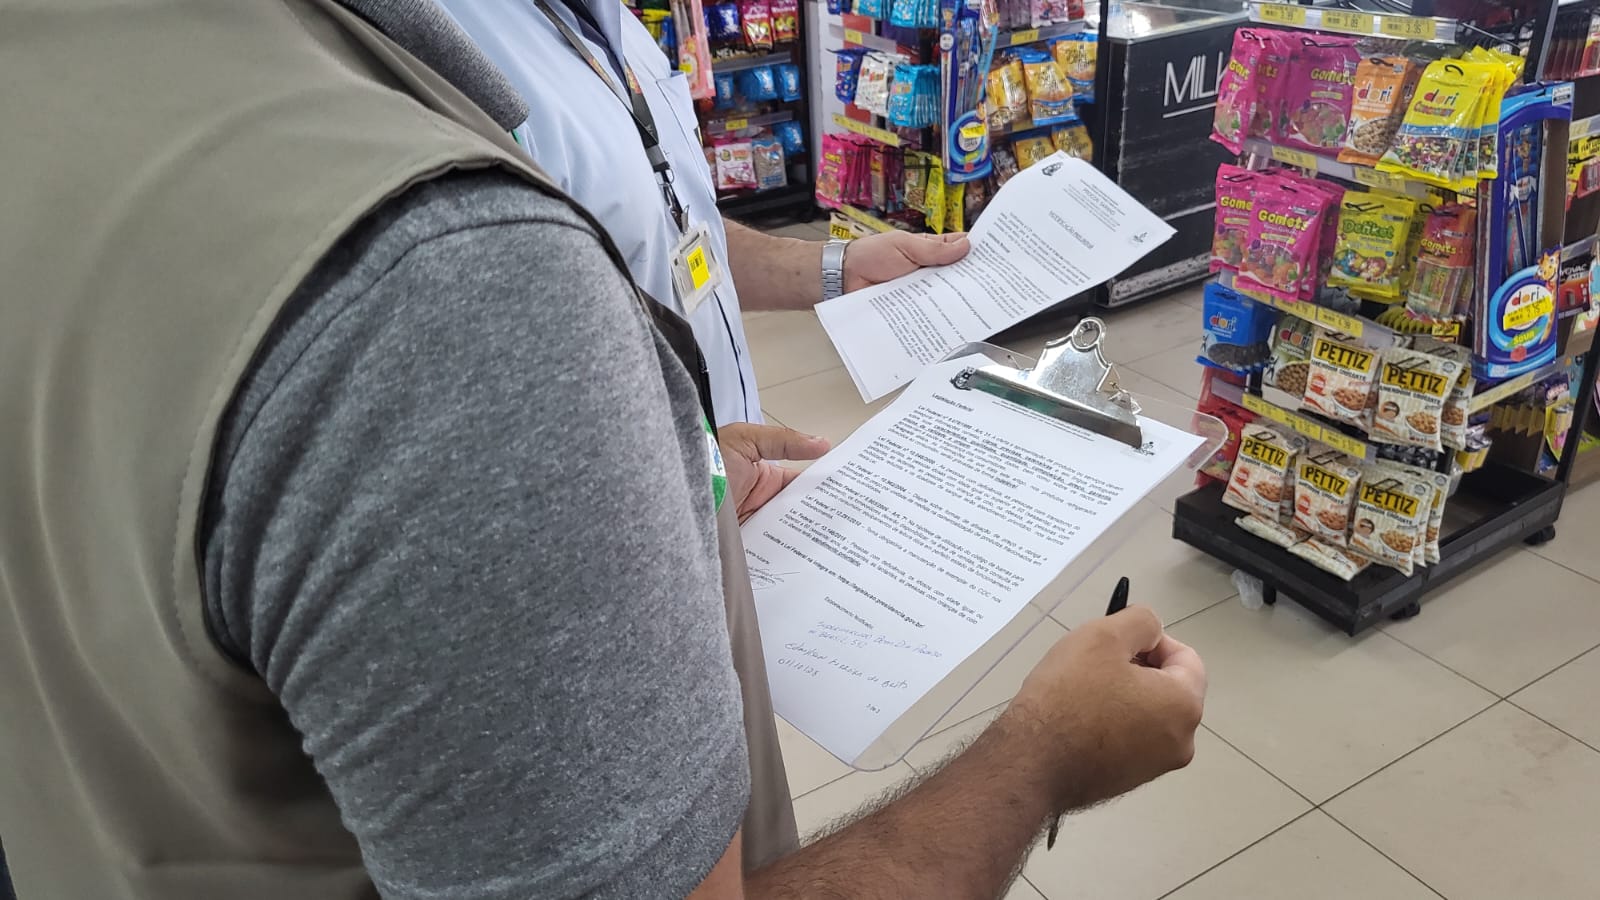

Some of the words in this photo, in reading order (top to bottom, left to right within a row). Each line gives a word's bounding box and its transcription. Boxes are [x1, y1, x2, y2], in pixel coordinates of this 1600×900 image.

[1358, 81, 1392, 103] dori
[1424, 89, 1459, 105] dori
[1221, 196, 1253, 211] Gome
[1259, 210, 1309, 231] Gomets
[1512, 286, 1540, 306] dori
[1210, 312, 1237, 331] dori
[1280, 325, 1313, 345] dori
[1318, 342, 1369, 371] PETTIZ
[1387, 366, 1443, 394] PETTIZ
[1243, 439, 1286, 467] PETTIZ
[1305, 466, 1345, 496] PETTIZ
[1364, 487, 1415, 515] PETTIZ
